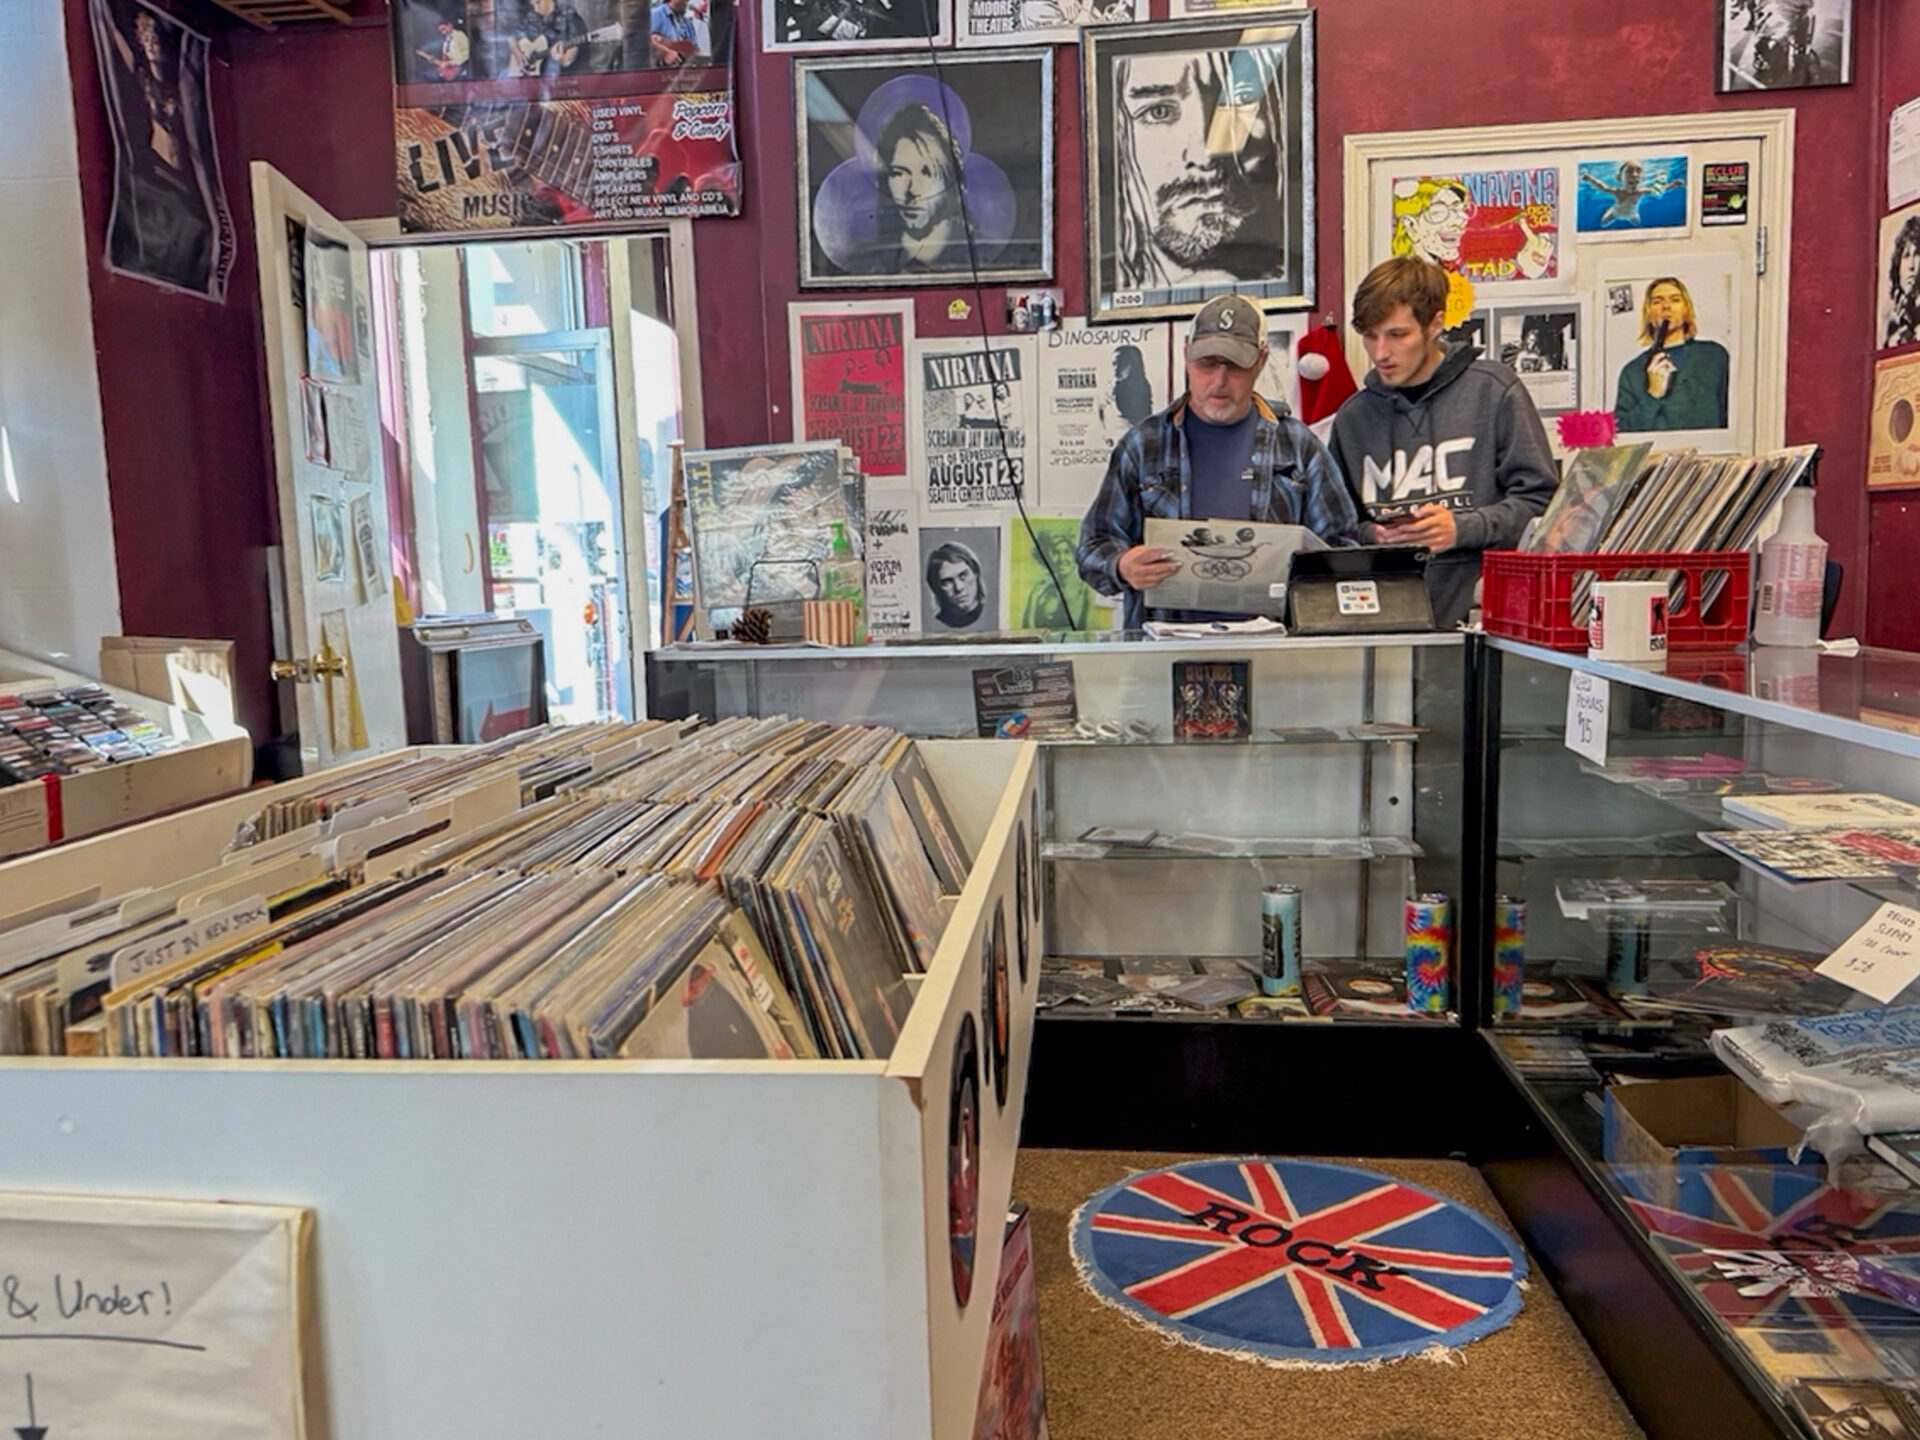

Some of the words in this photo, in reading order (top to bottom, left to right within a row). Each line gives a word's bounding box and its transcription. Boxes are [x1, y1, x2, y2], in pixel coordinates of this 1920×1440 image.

[970, 18, 1014, 34] THEATRE
[592, 107, 617, 118] USED
[672, 101, 728, 121] Popcorn
[592, 120, 614, 131] CD'S
[672, 122, 687, 141] &
[689, 119, 732, 141] Candy
[408, 116, 516, 194] LIVE
[593, 157, 653, 168] TURNTABLES
[593, 170, 647, 182] AMPLIFIERS
[594, 184, 642, 195] SPEAKERS
[594, 196, 627, 208] SELECT
[630, 194, 650, 205] NEW
[652, 193, 677, 204] VINYL
[679, 192, 699, 203] AND
[701, 191, 724, 201] CD'S
[462, 192, 533, 219] MUSIC
[594, 208, 612, 219] ART
[613, 207, 633, 218] AND
[634, 206, 663, 217] MUSIC
[664, 204, 728, 216] MEMORABILIA
[1466, 261, 1516, 277] TAD
[1219, 308, 1235, 330] S
[810, 316, 897, 353] NIRVANA
[1048, 328, 1131, 349] DINOSAUR
[928, 351, 1016, 389] NIRVANA
[1057, 373, 1098, 389] NIRVANA
[929, 461, 993, 487] AUGUST
[999, 459, 1023, 485] 23
[1362, 436, 1476, 505] MAC
[928, 486, 957, 503] SEATTLE
[958, 485, 984, 502] CENTER
[128, 940, 177, 973] JUST
[182, 932, 199, 955] IN
[205, 918, 229, 940] NEW
[232, 907, 267, 930] STOCK
[1184, 1201, 1410, 1291] ROCK
[3, 1274, 39, 1321] &
[54, 1273, 173, 1319] Under!
